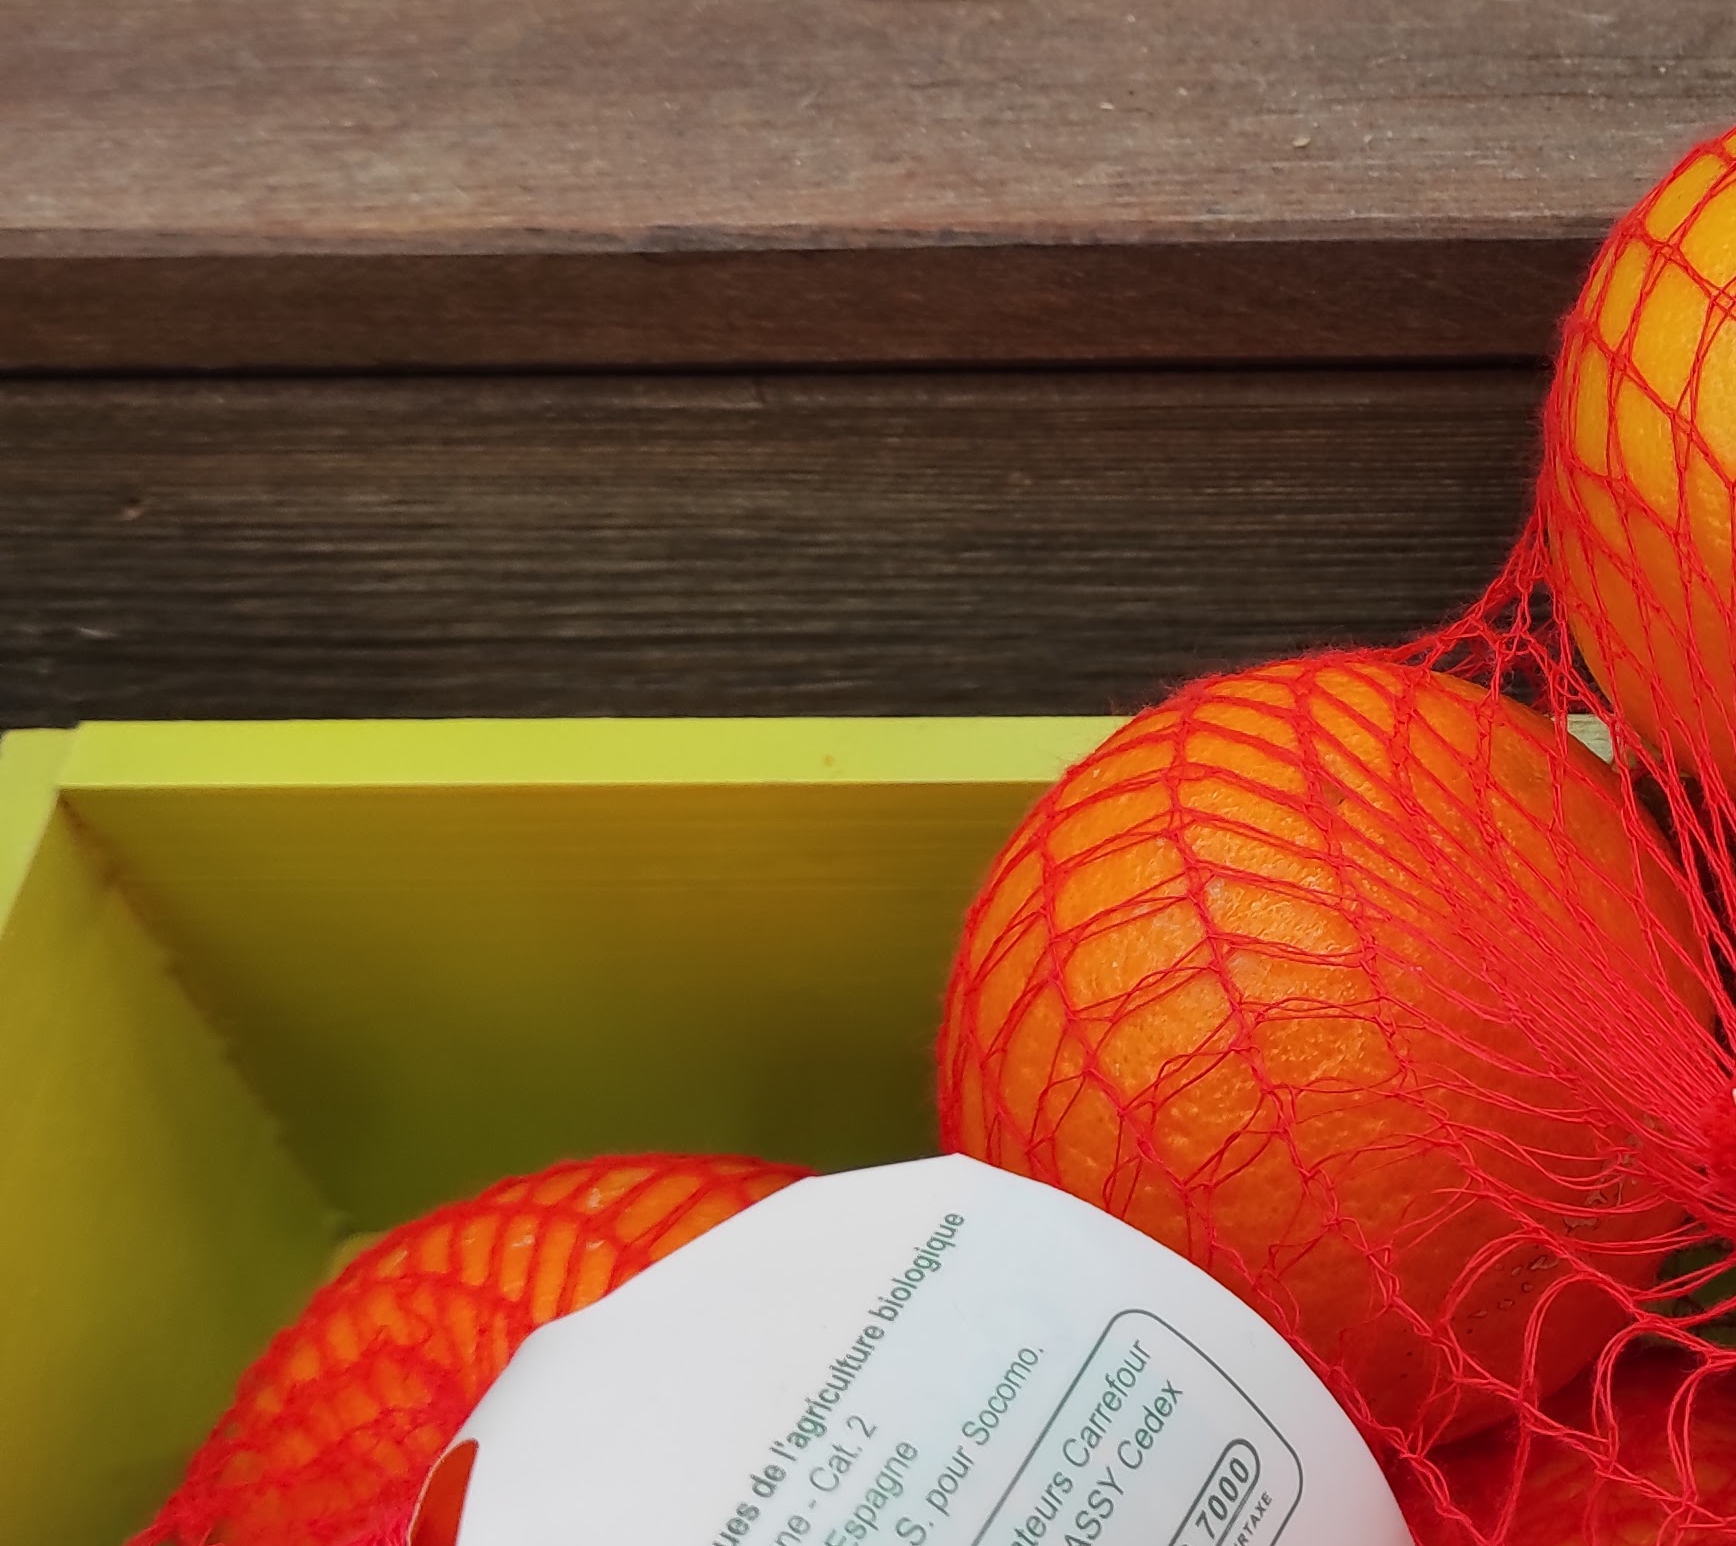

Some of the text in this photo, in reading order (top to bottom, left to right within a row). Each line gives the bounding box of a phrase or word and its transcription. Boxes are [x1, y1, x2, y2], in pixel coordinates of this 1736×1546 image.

[868, 1211, 965, 1323] biologique
[769, 1322, 885, 1463] l'agriculture
[924, 1442, 978, 1517] pour
[961, 1345, 1045, 1448] Socomo.
[1060, 1338, 1152, 1470] Carrefour
[1118, 1380, 1185, 1471] Cedex
[751, 1462, 788, 1499] de
[809, 1443, 864, 1494] Cat.
[845, 1413, 878, 1440] 2
[1192, 1456, 1253, 1544] 7000
